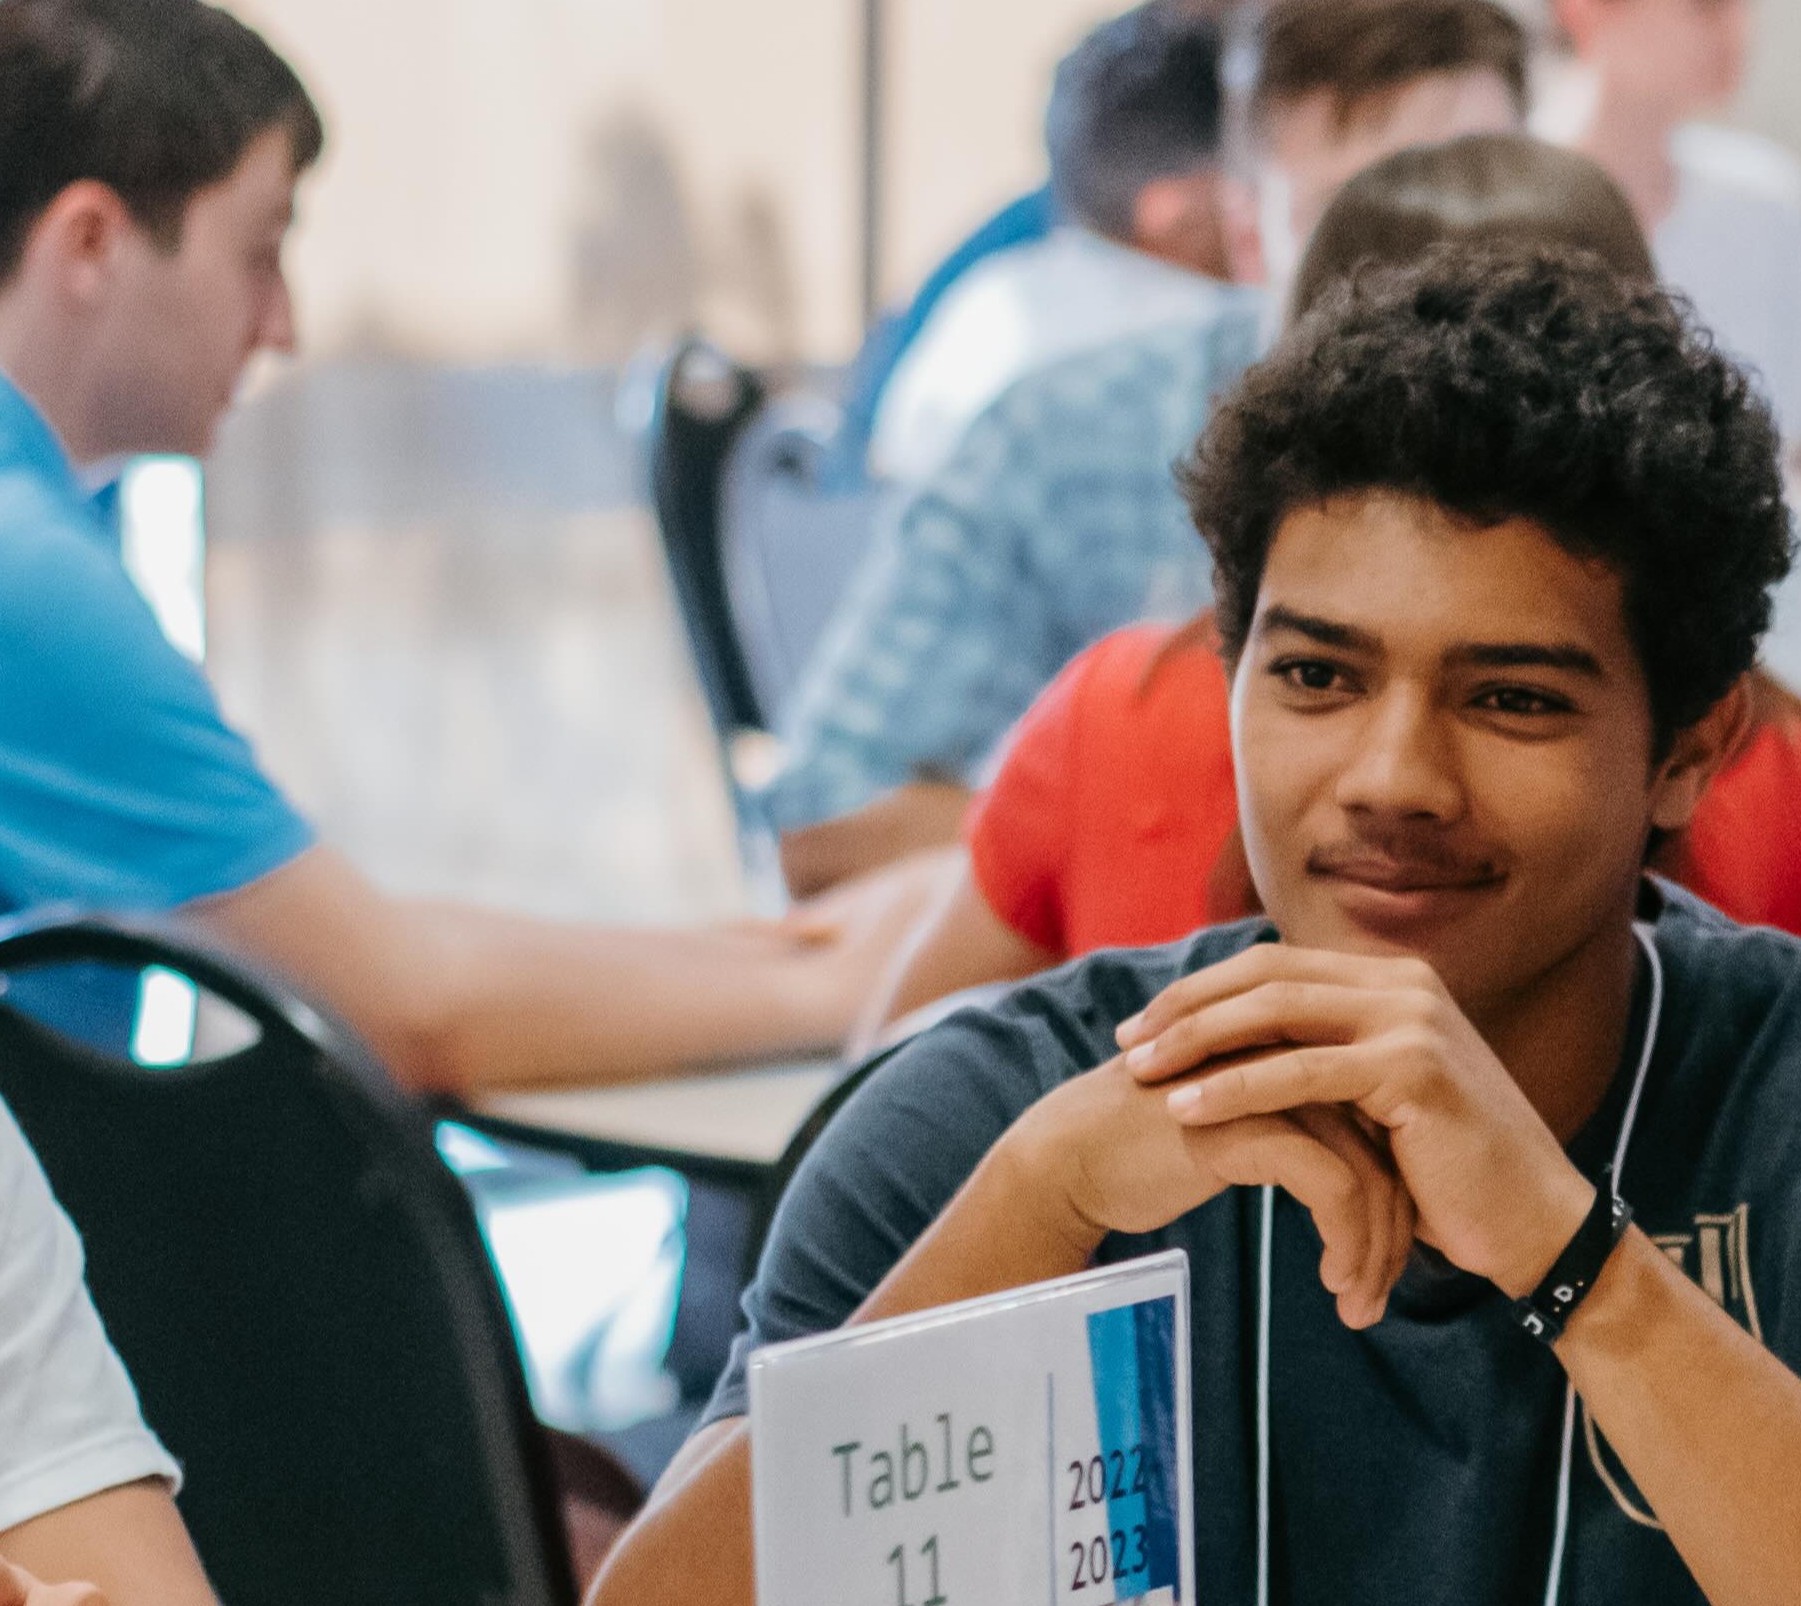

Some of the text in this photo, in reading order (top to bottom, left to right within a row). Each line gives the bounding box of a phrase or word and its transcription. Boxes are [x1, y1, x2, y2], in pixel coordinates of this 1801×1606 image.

[832, 1413, 995, 1517] Table
[1068, 1446, 1147, 1512] 2022
[1070, 1525, 1150, 1592] 2023
